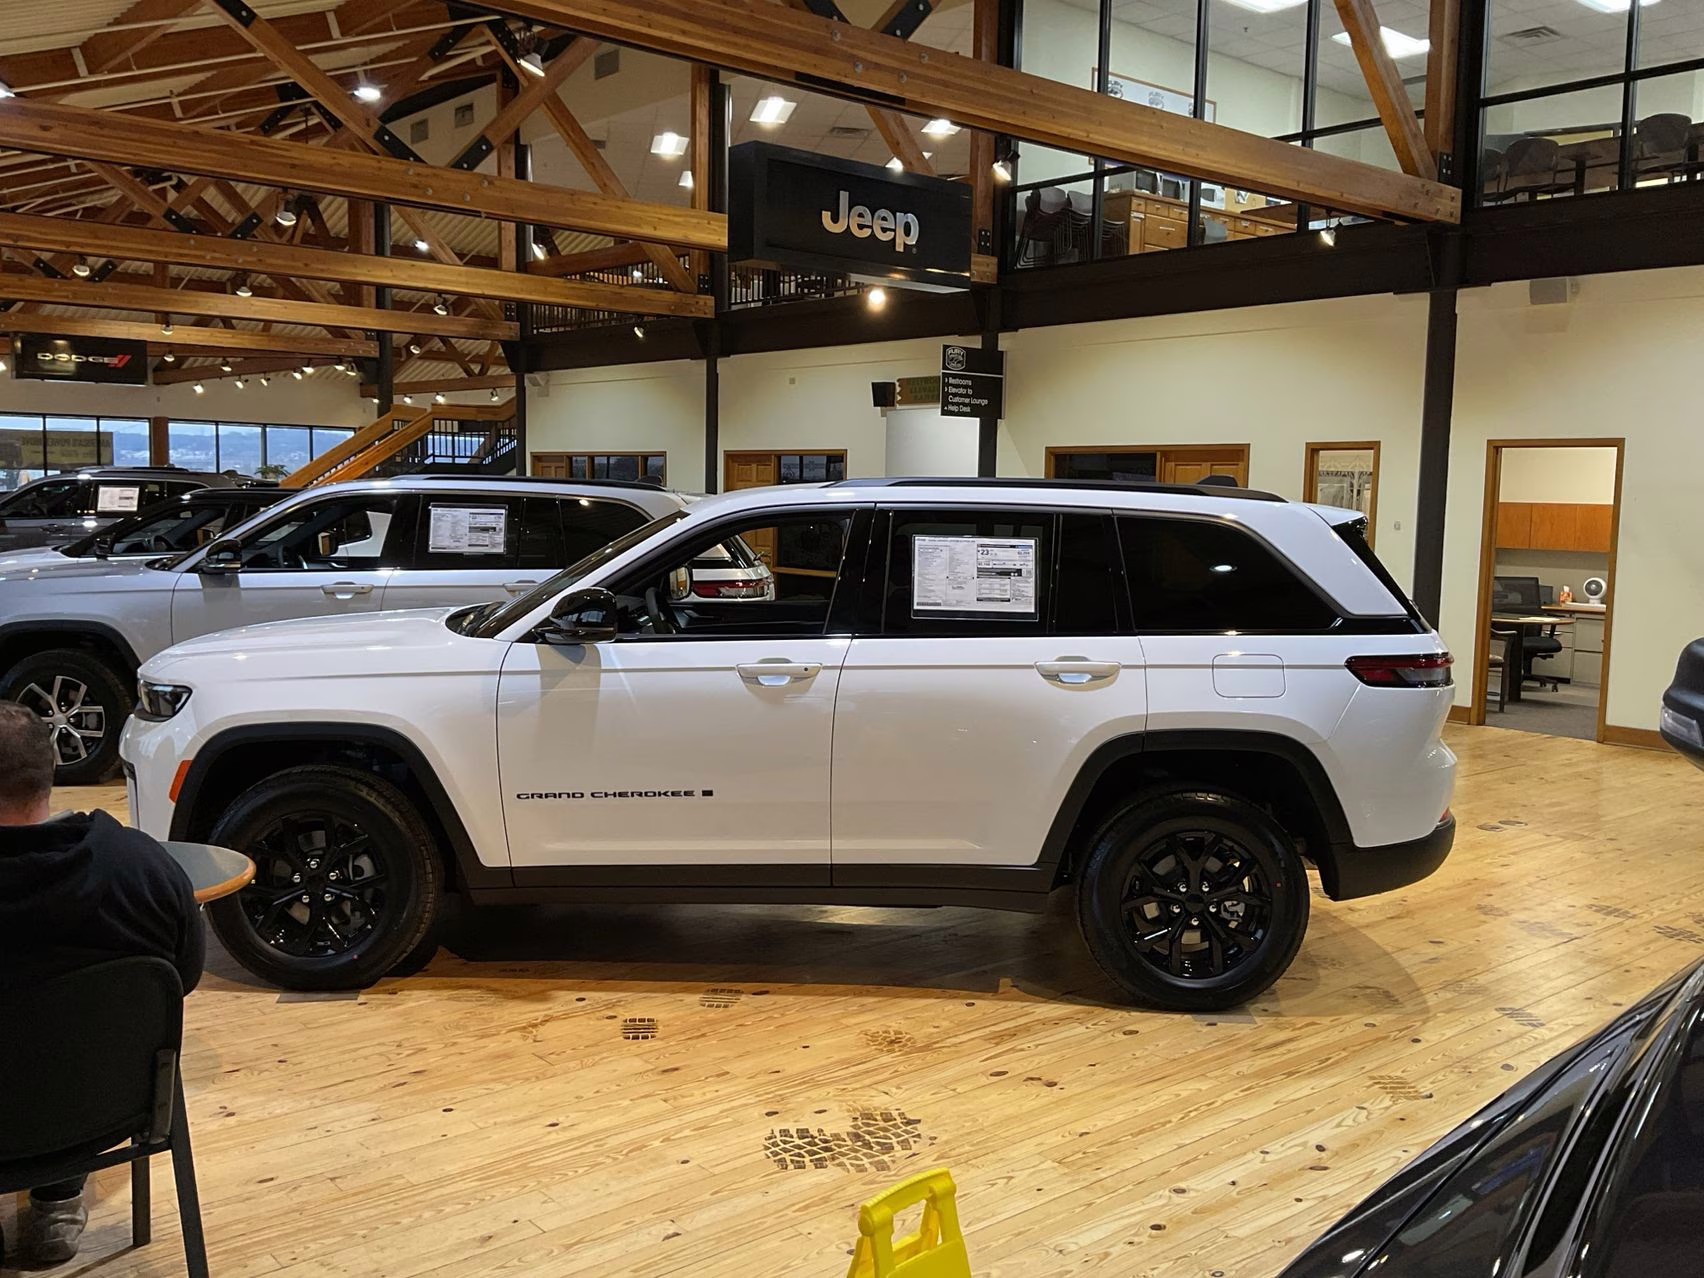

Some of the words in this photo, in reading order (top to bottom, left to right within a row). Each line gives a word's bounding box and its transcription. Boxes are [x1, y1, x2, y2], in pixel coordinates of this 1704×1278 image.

[822, 190, 919, 252] Jeep
[37, 352, 119, 364] DODGE
[948, 377, 972, 385] Restrooms
[948, 386, 966, 394] Elevator
[948, 395, 970, 403] Customer
[971, 397, 988, 405] Lounge
[948, 404, 959, 412] Help
[590, 790, 696, 798] CHEROKEE
